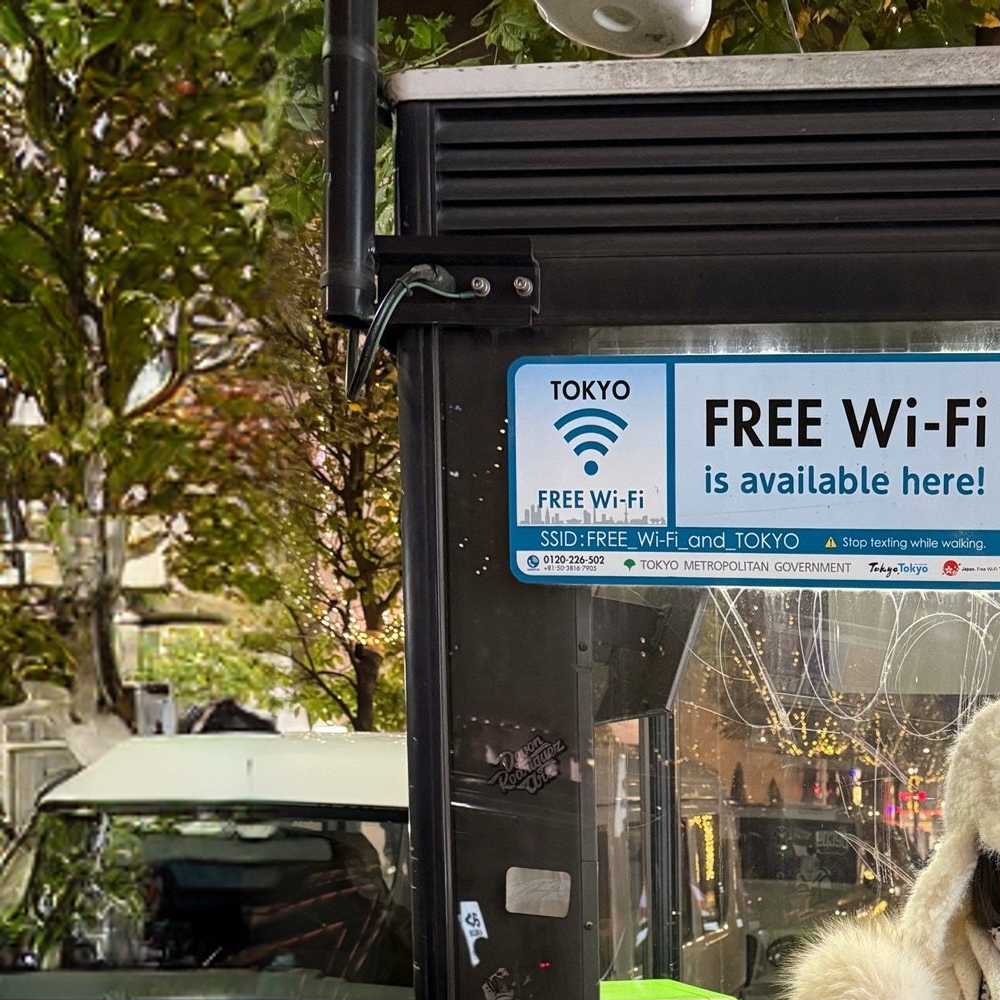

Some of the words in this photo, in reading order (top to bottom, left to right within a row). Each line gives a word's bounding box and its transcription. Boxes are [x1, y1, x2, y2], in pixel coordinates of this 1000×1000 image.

[550, 380, 631, 400] TOKYO
[704, 398, 823, 447] FREE
[841, 397, 987, 448] Wi-Fi
[704, 465, 729, 494] is
[740, 465, 890, 496] available
[902, 465, 986, 496] here!
[538, 490, 584, 509] FREE
[590, 489, 644, 509] Wi-Fi
[842, 536, 868, 549] Stop
[870, 537, 908, 550] texting
[908, 537, 939, 549] while
[941, 537, 987, 551] walking.
[543, 555, 605, 565] 0120-226-502
[640, 559, 679, 571] TOKYO
[684, 560, 769, 572] METROPOLITAN
[774, 561, 852, 573] GOVERNMENT
